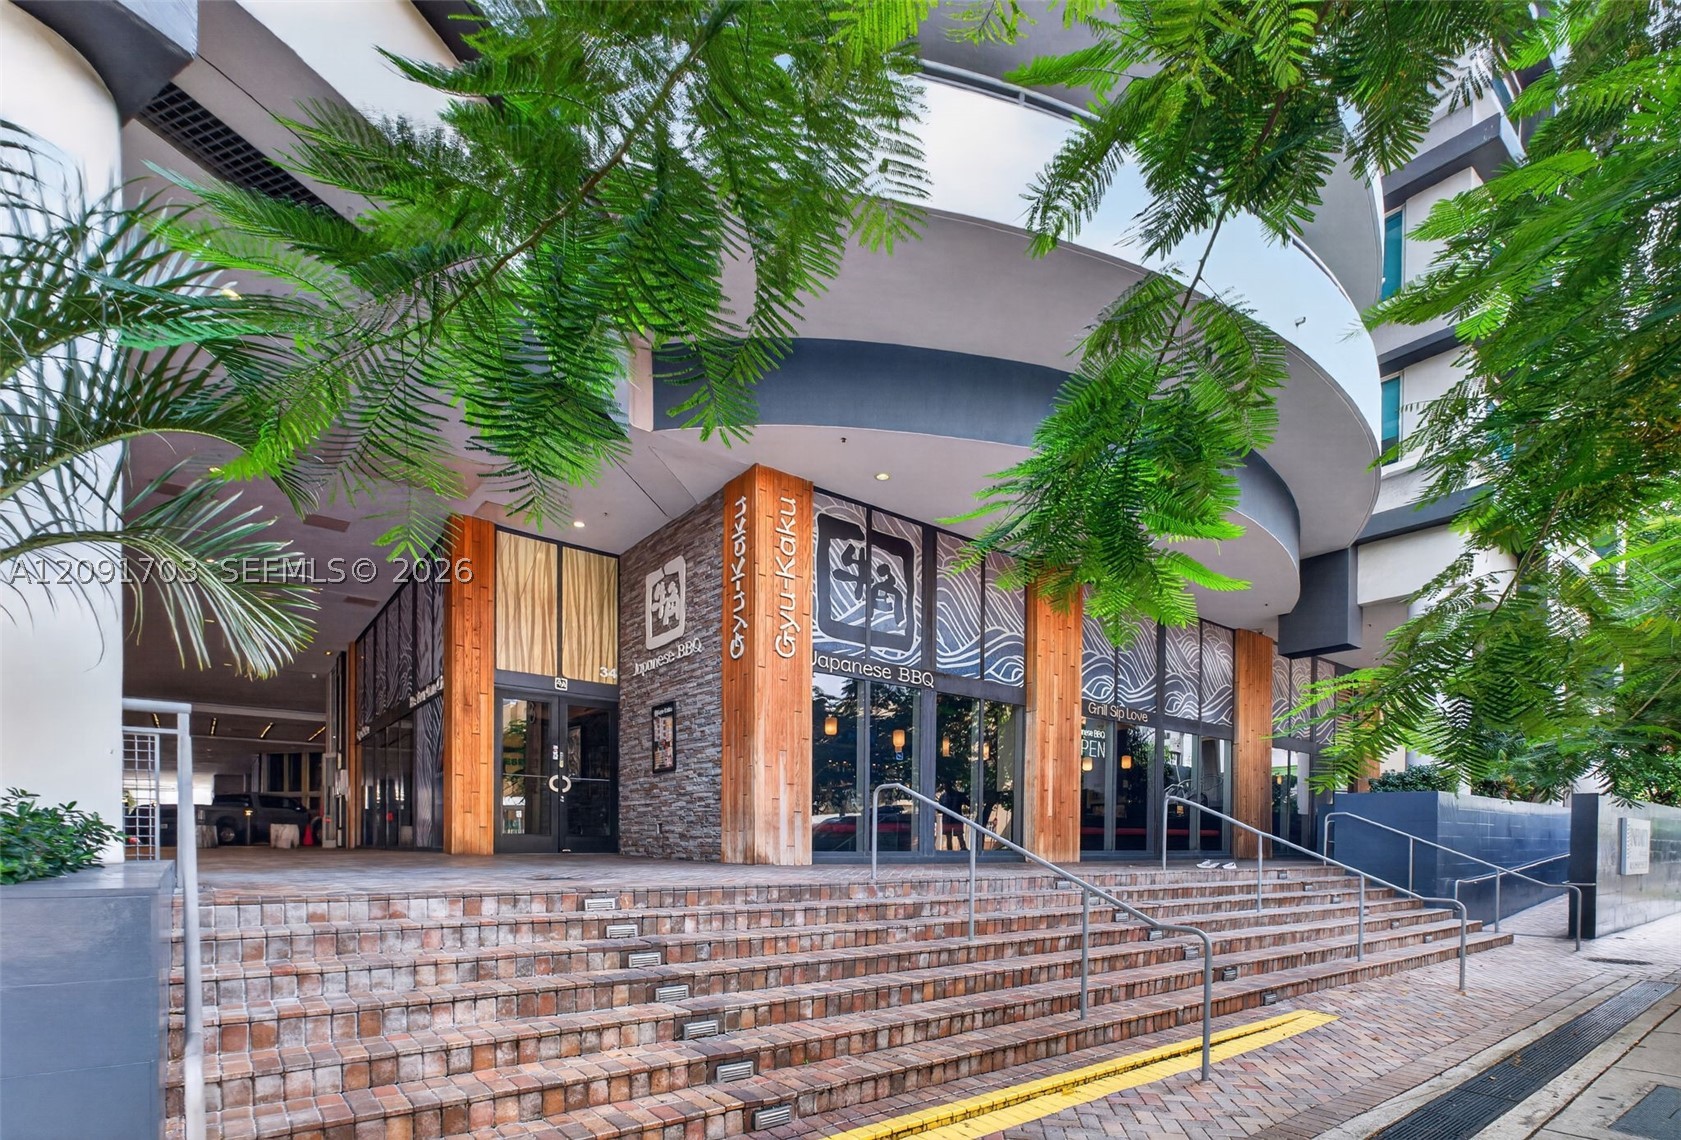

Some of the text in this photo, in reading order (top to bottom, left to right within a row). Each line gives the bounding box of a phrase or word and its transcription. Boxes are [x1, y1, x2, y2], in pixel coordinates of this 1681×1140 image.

[730, 495, 748, 661] Gyu-Kaku
[774, 496, 801, 659] Gyu-Kaku
[631, 637, 703, 678] Japanese BBQ
[811, 650, 936, 689] Japanese BBQ
[1088, 702, 1148, 722] Grill Sip Love
